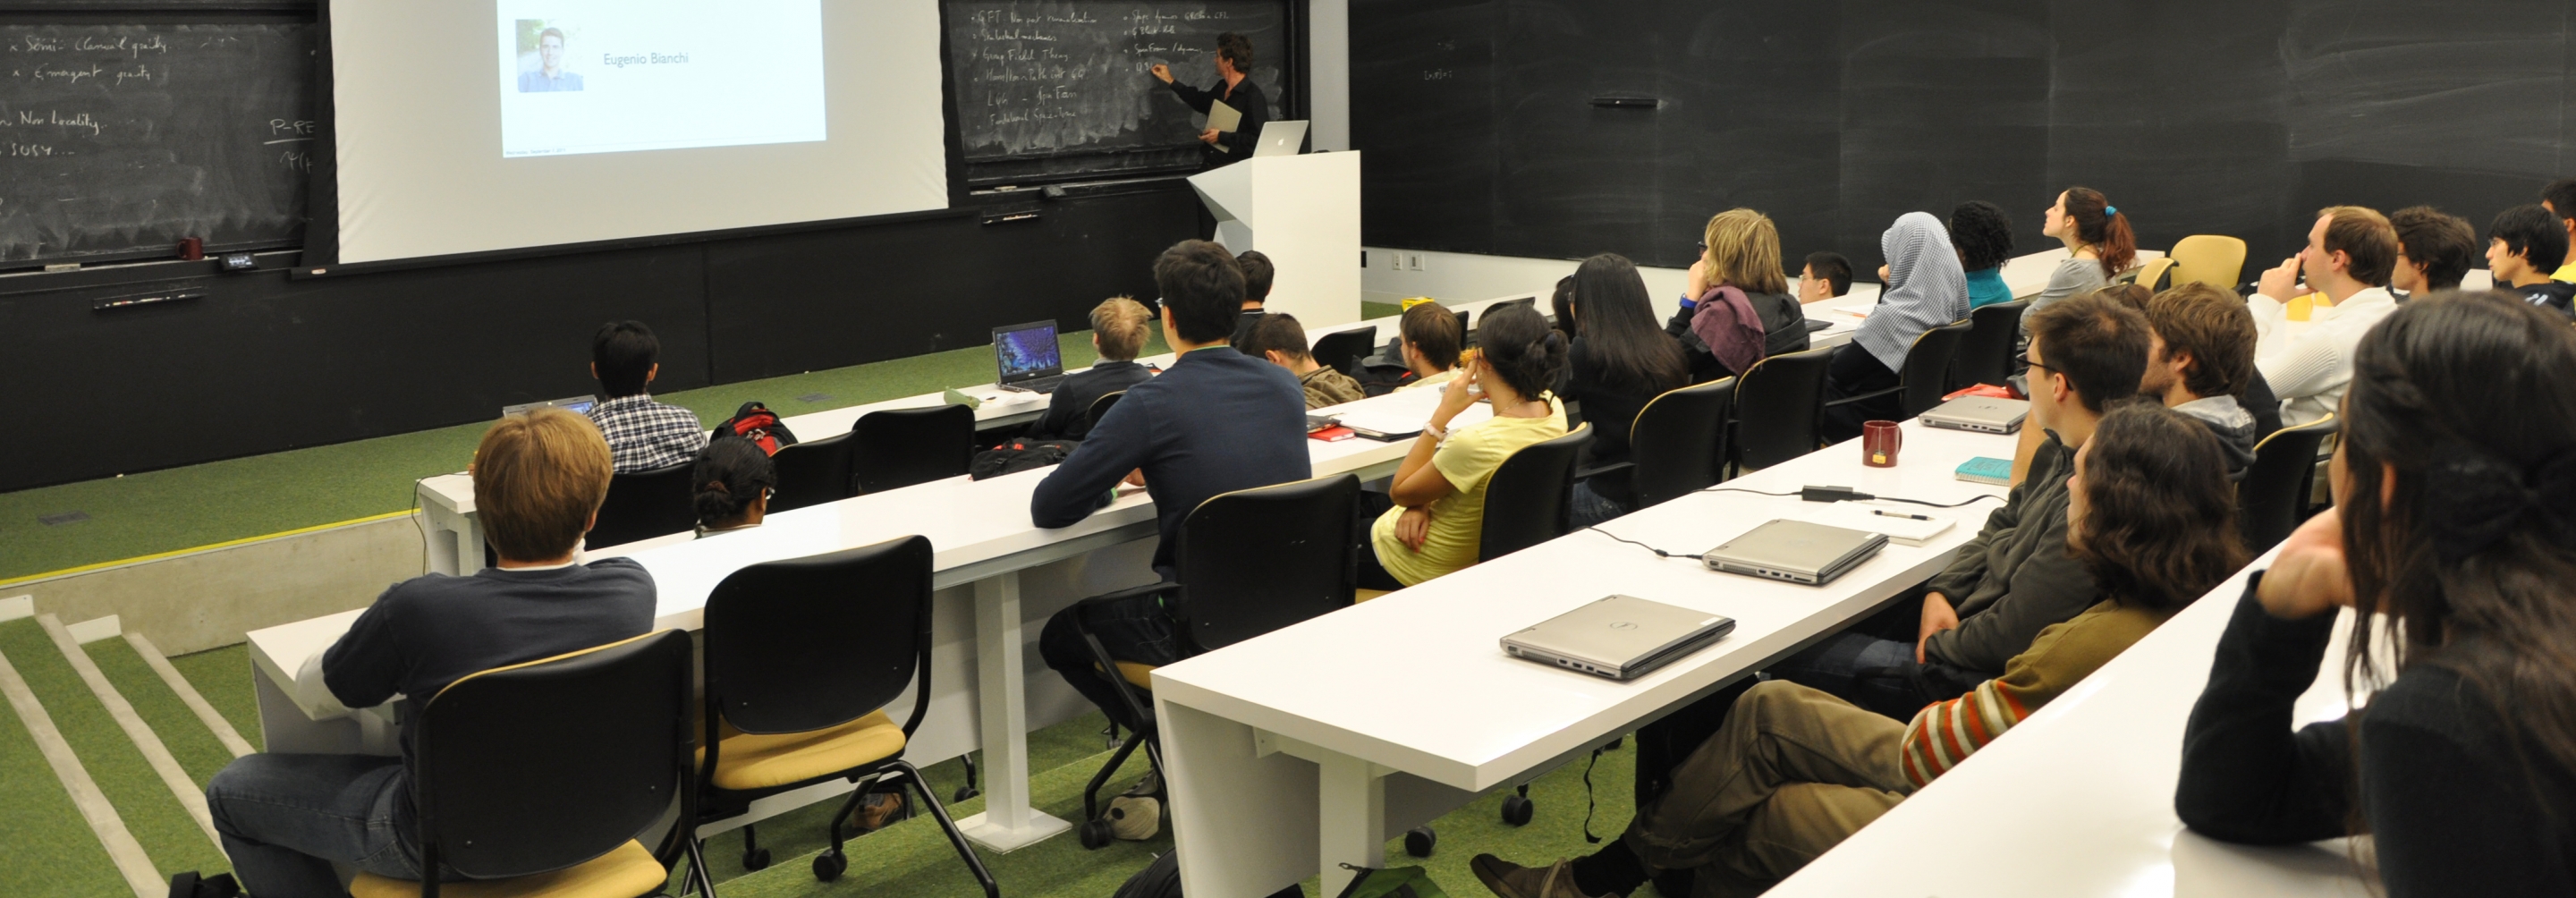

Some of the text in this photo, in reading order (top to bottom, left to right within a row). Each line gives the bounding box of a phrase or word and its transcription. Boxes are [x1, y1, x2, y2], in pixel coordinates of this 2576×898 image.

[603, 52, 689, 69] Eugenio Bianchi
[20, 110, 45, 125] Non
